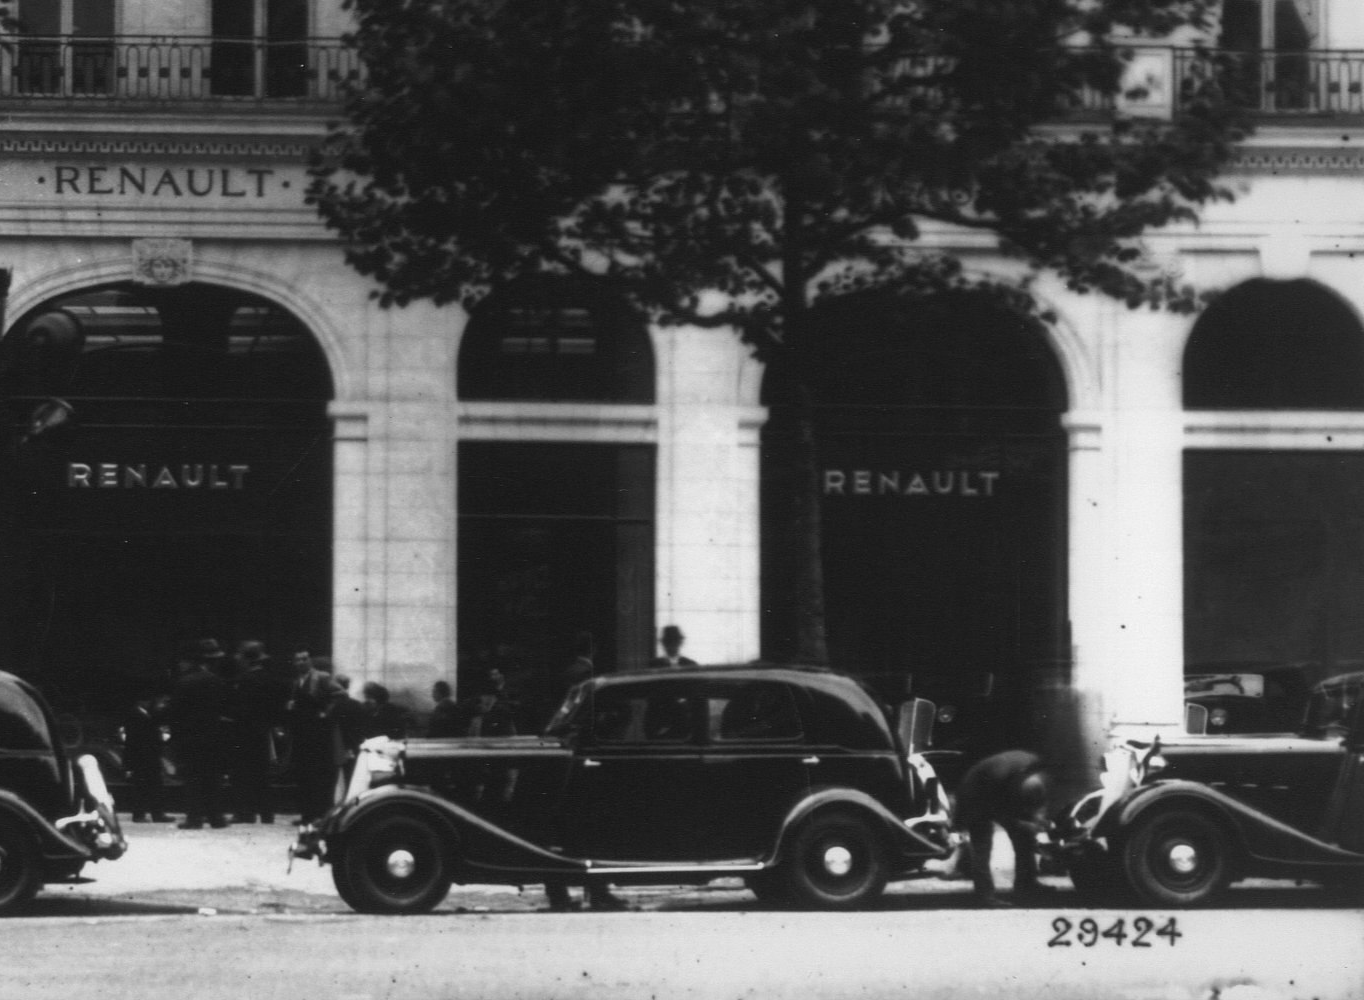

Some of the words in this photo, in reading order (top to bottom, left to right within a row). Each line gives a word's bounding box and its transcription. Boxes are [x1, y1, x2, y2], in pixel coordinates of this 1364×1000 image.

[55, 166, 274, 198] RENAULT
[68, 462, 250, 489] RENAULT
[824, 470, 1001, 496] RENAULT
